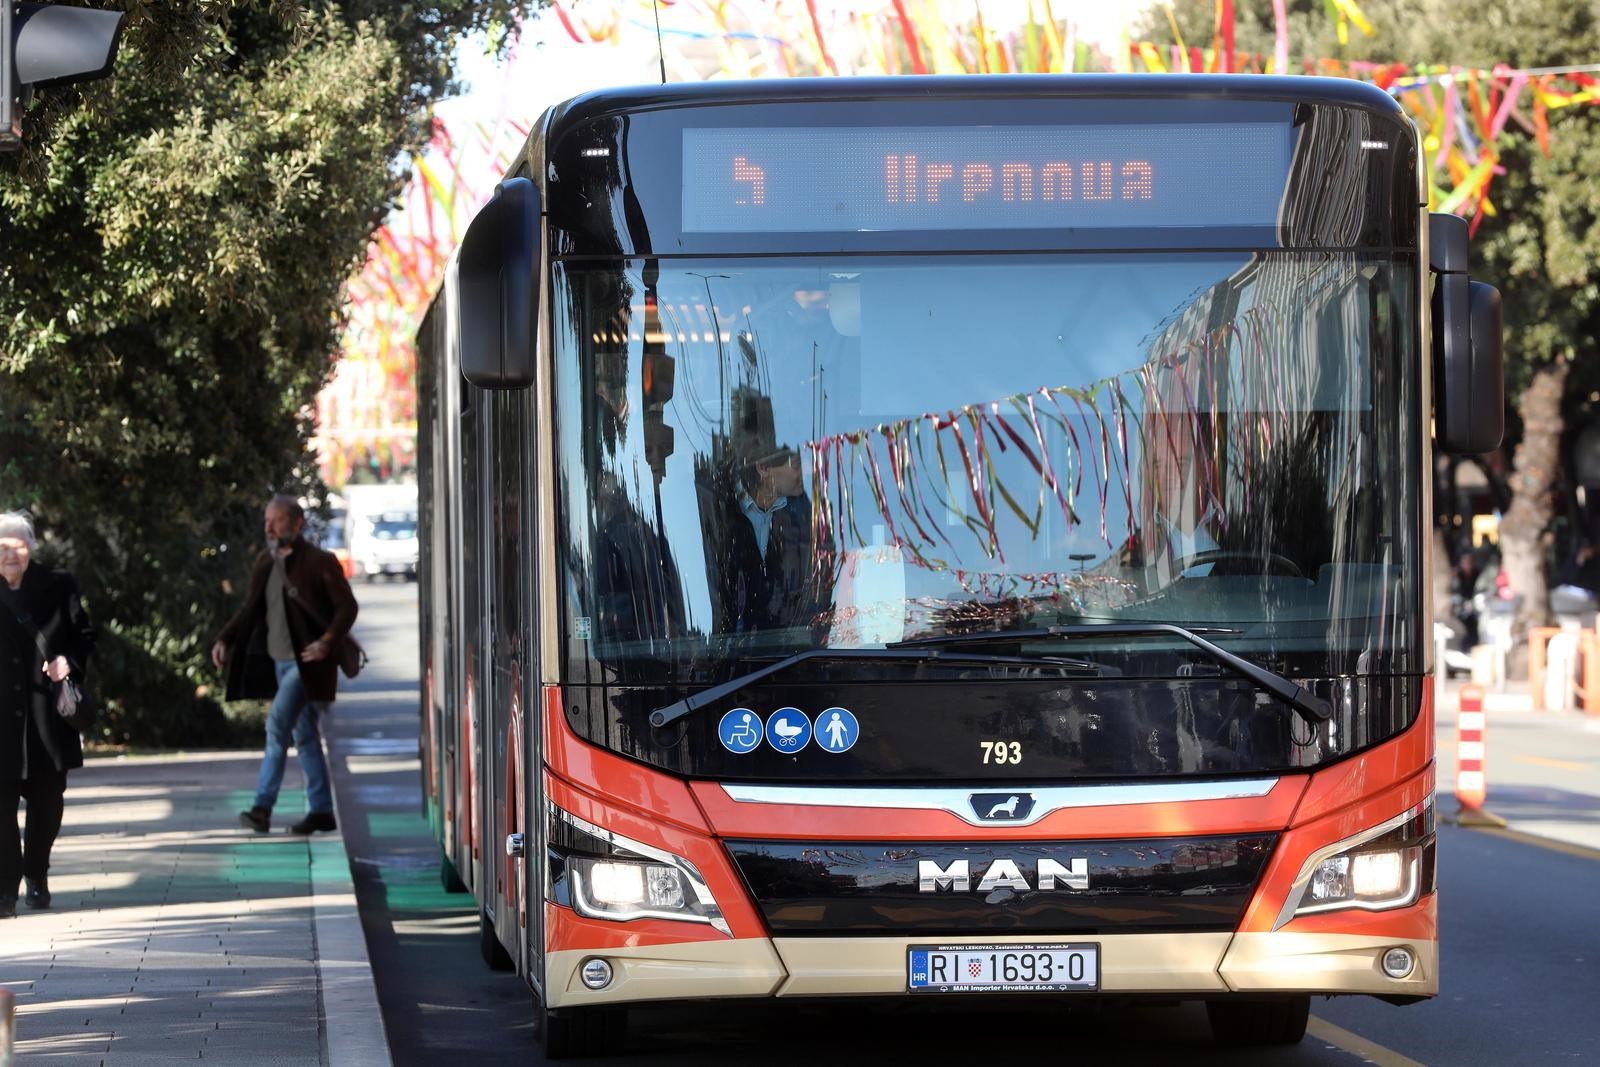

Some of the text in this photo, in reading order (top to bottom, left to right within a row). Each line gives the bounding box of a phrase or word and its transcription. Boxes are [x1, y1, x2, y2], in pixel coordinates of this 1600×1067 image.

[980, 741, 1022, 765] 793
[918, 857, 1090, 894] MAN
[913, 973, 926, 981] HR
[931, 953, 1084, 982] RI 1693-0
